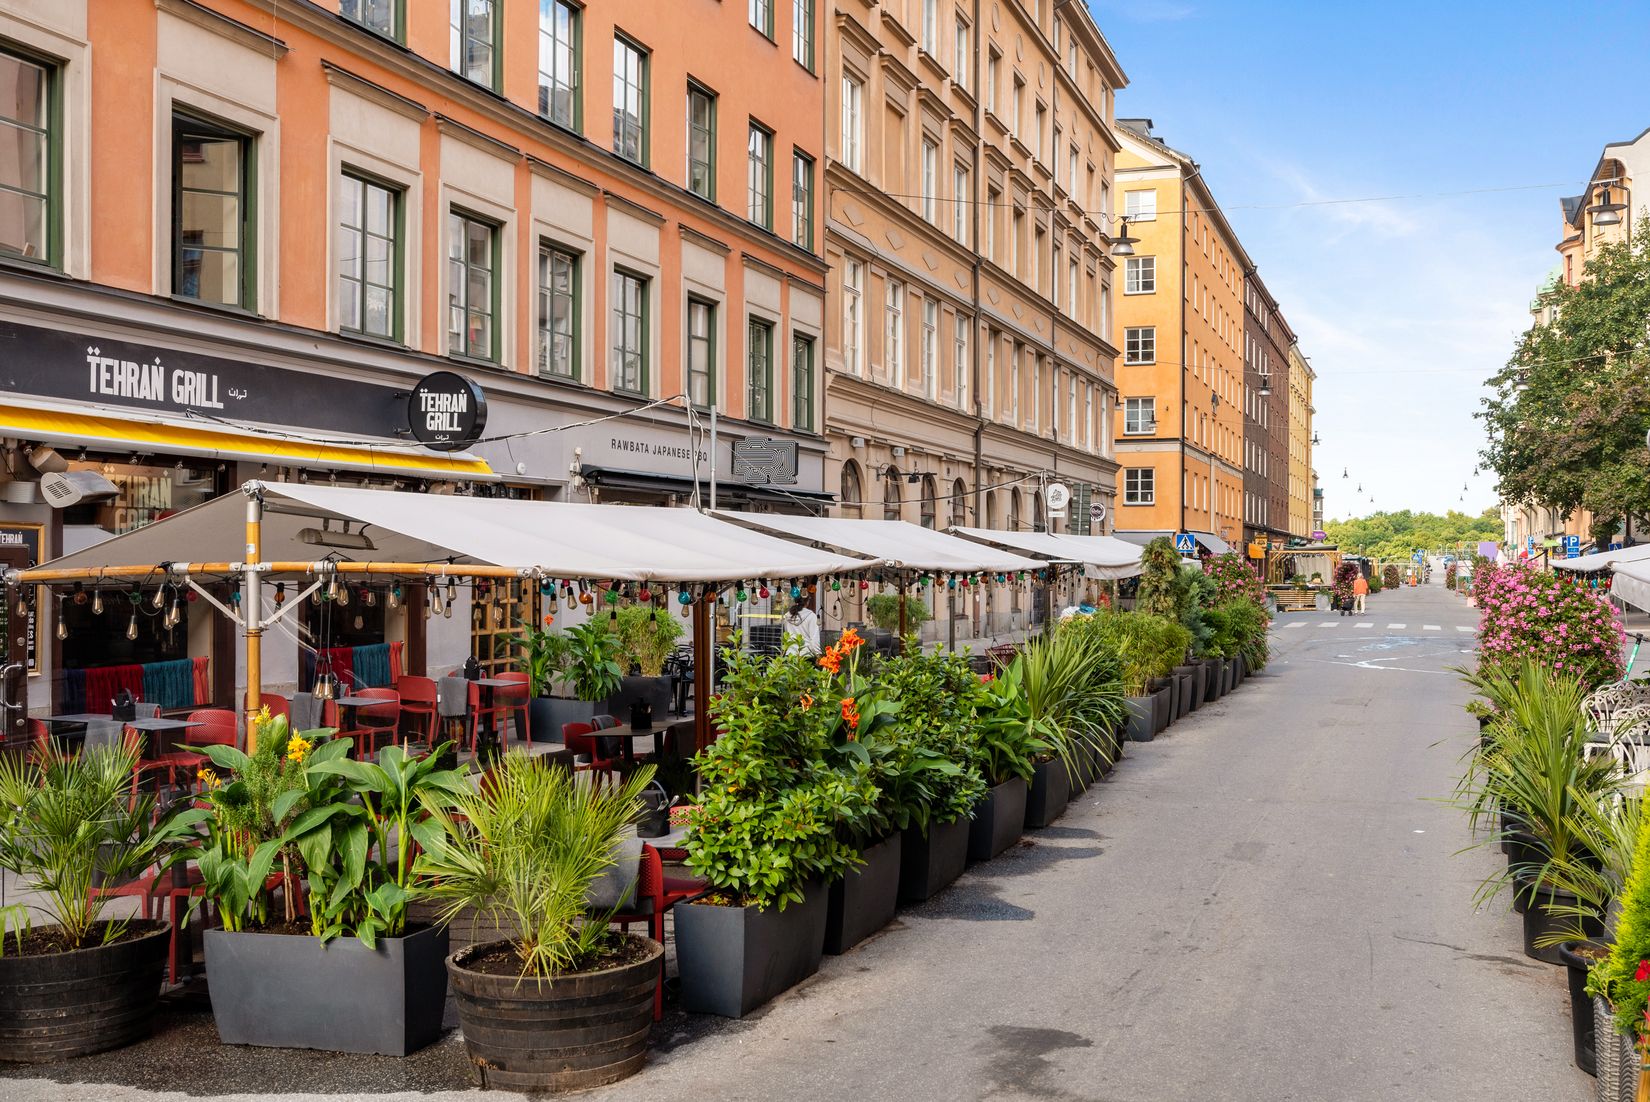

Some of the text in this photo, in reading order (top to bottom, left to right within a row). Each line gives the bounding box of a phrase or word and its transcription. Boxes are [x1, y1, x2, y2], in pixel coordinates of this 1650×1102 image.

[172, 369, 224, 409] GRILL
[426, 412, 461, 431] GRILL
[611, 438, 649, 454] RAWBATA
[653, 445, 690, 459] JAPANESE
[1570, 536, 1577, 546] P
